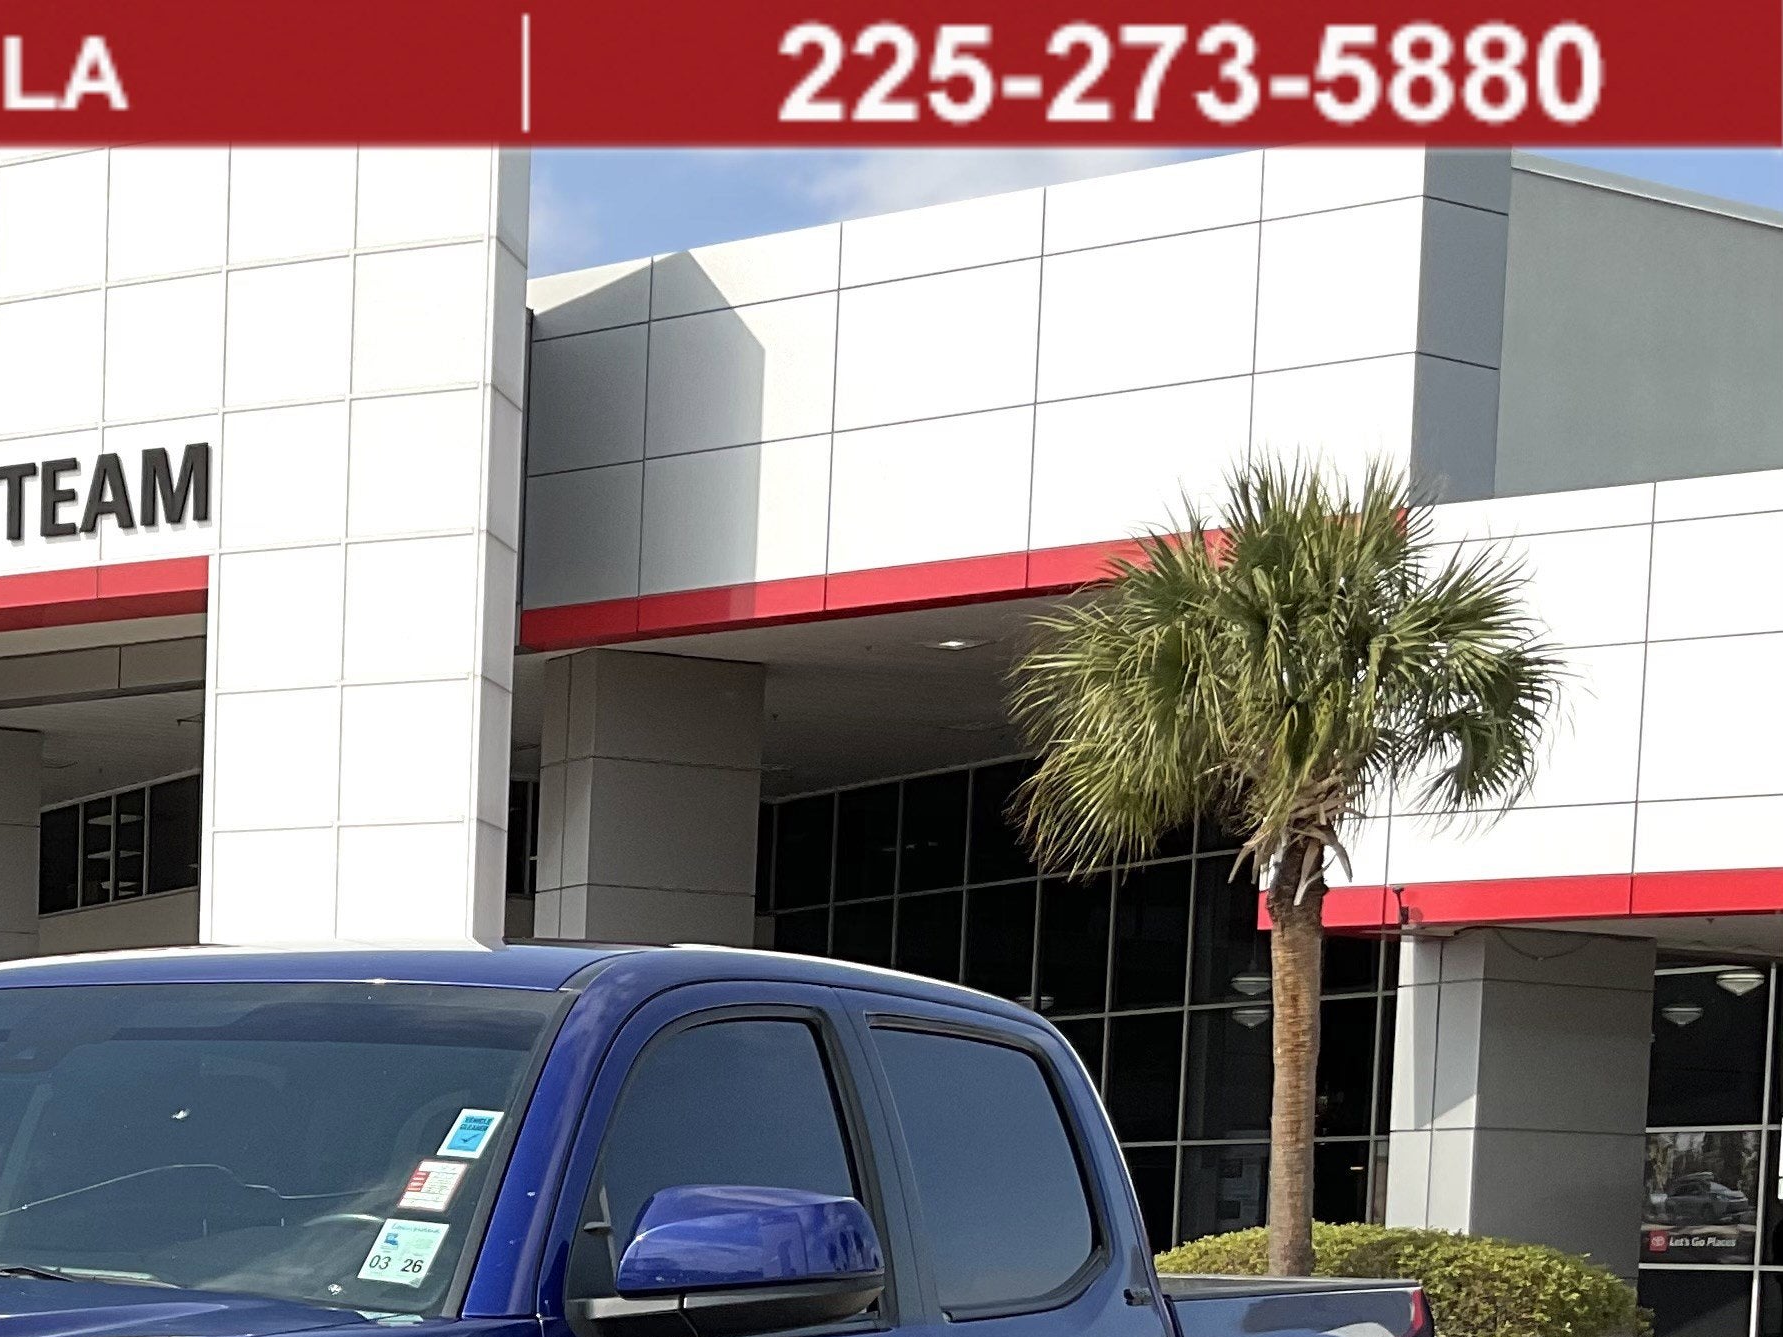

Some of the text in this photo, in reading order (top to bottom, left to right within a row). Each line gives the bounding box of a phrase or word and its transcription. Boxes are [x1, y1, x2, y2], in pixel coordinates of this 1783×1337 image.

[1691, 1236, 1706, 1247] Go
[369, 1255, 424, 1273] 03 26
